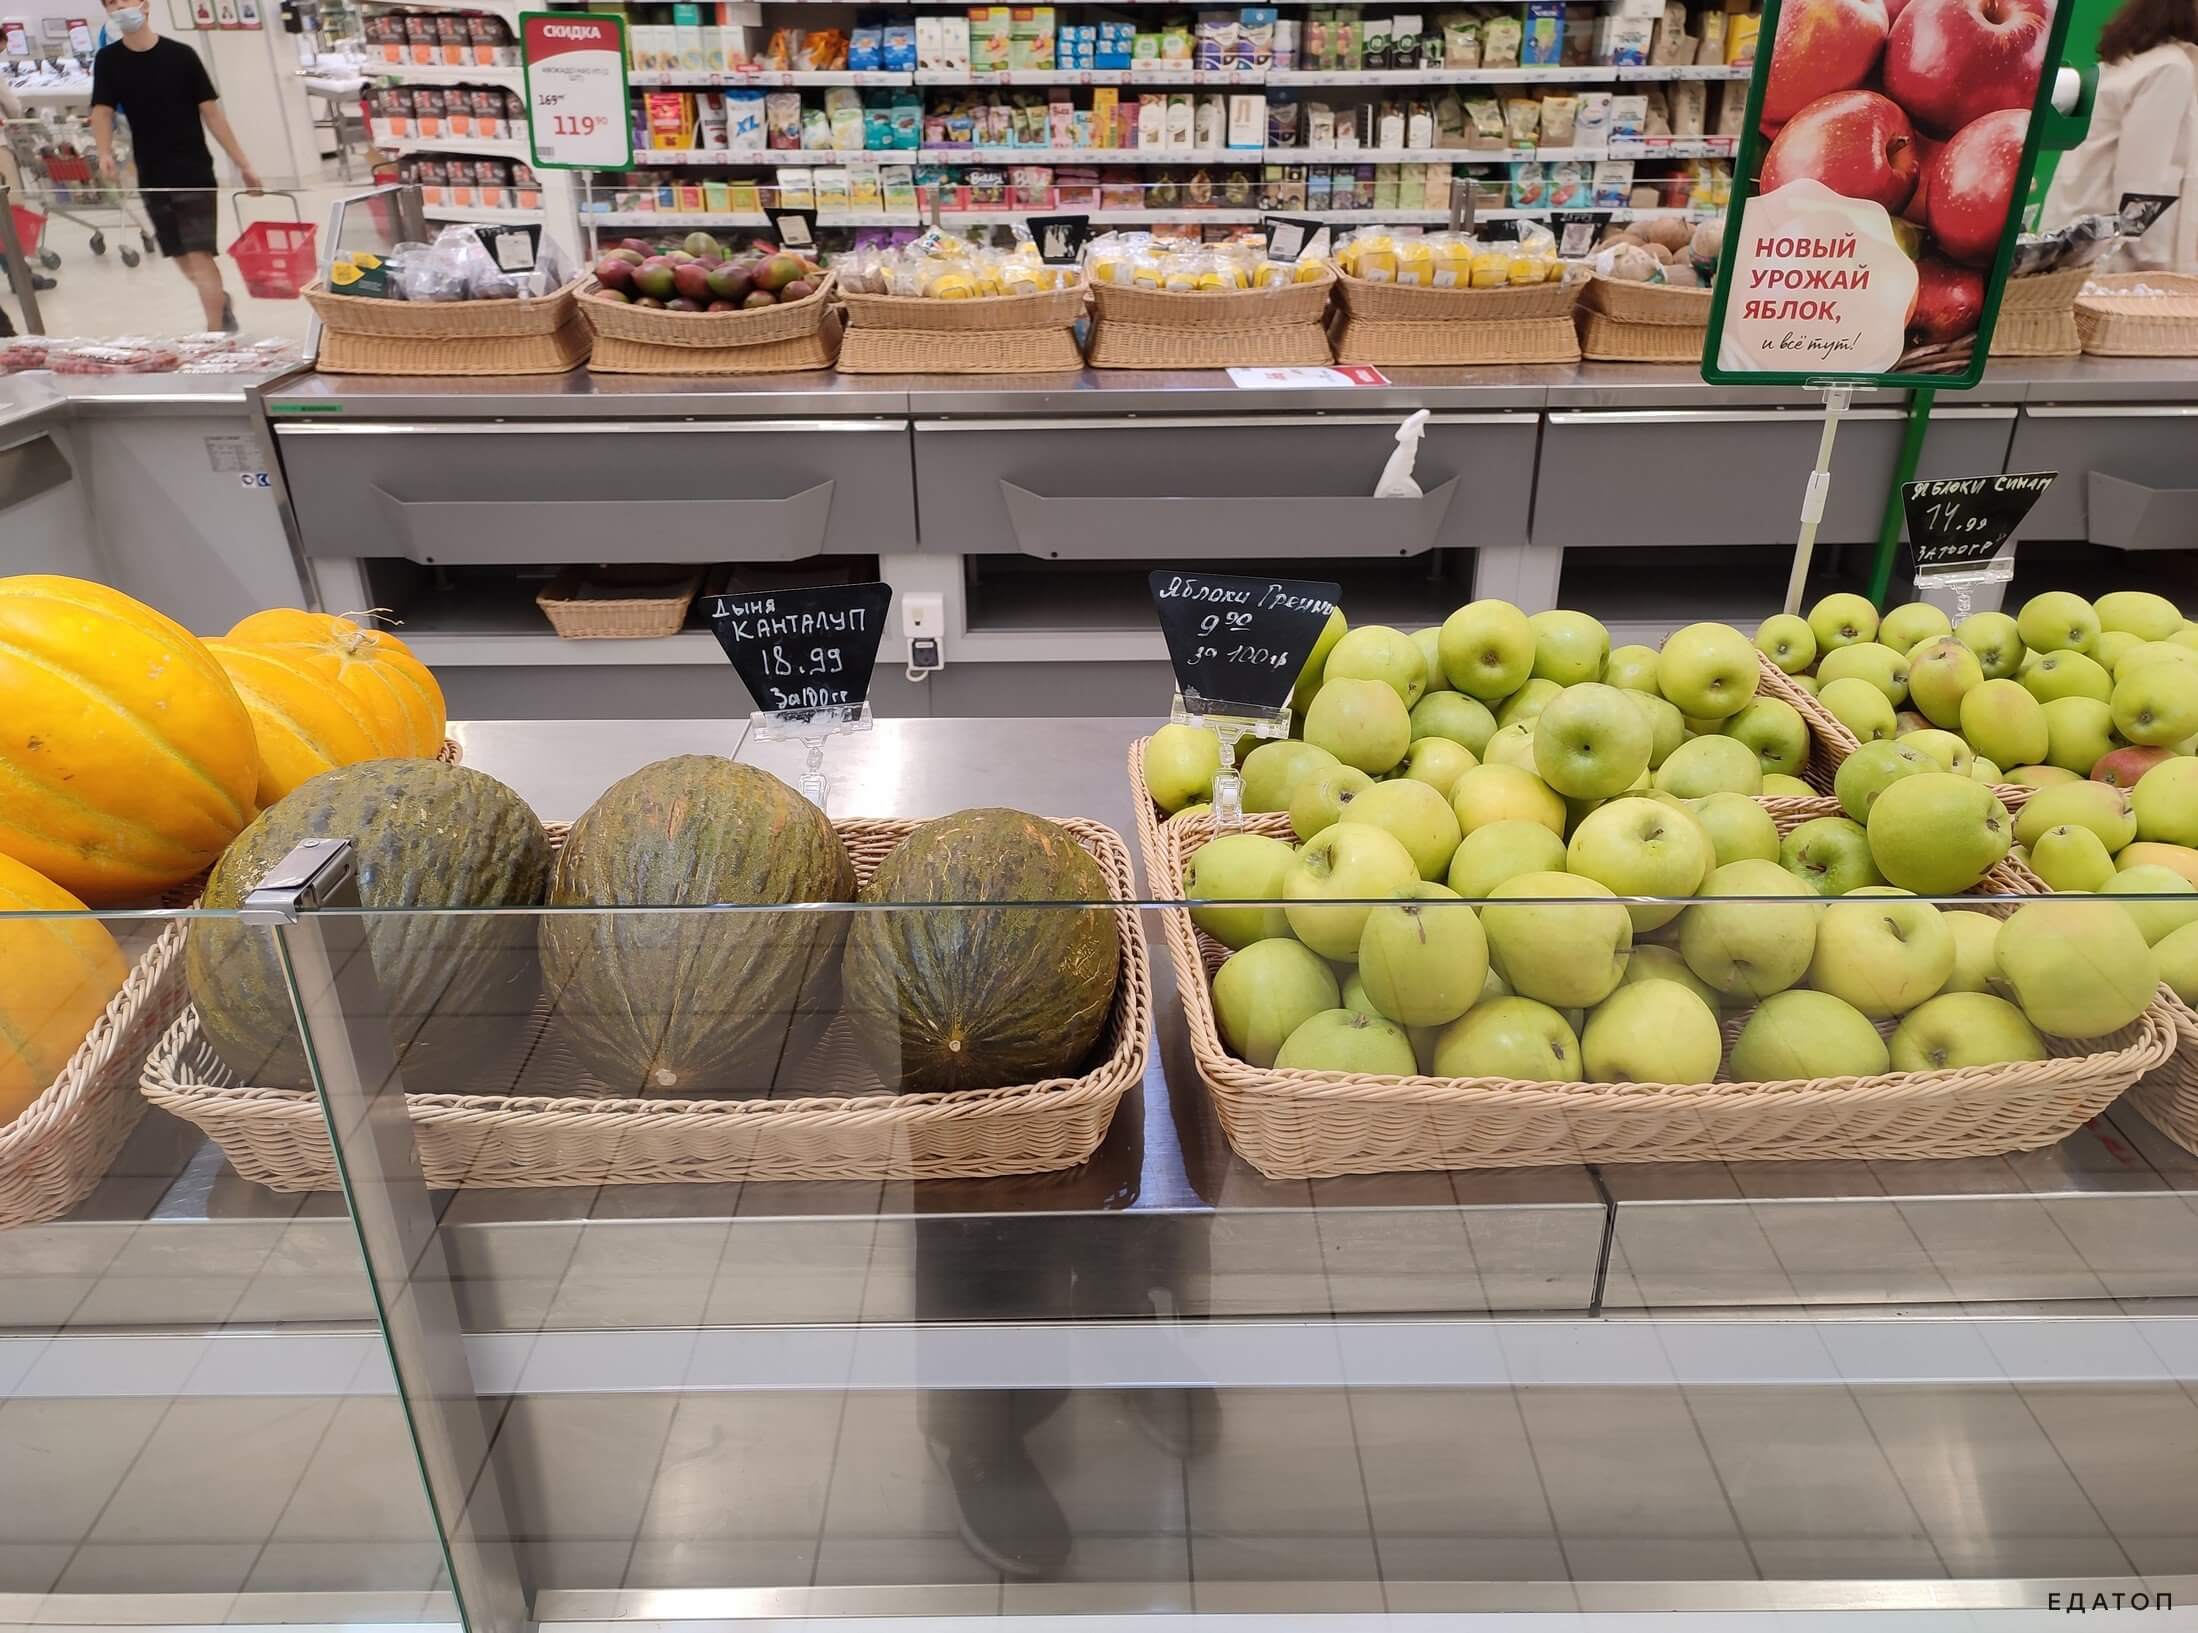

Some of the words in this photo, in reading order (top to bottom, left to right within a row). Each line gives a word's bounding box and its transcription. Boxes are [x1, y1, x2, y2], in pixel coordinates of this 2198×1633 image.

[543, 25, 602, 41] СКИДКА
[553, 116, 594, 135] 119
[1755, 232, 1857, 258] НОВЫЙ
[1749, 264, 1871, 290] УРОЖАЙ
[1743, 299, 1842, 324] ЯБЛОК,
[1761, 339, 1774, 350] и
[1779, 332, 1806, 350] всё
[1911, 480, 1986, 500] ЯБЛОКИ
[1159, 576, 1250, 604] Яблоки
[732, 608, 866, 642] КАНТАЛУП
[761, 646, 843, 675] 18.99
